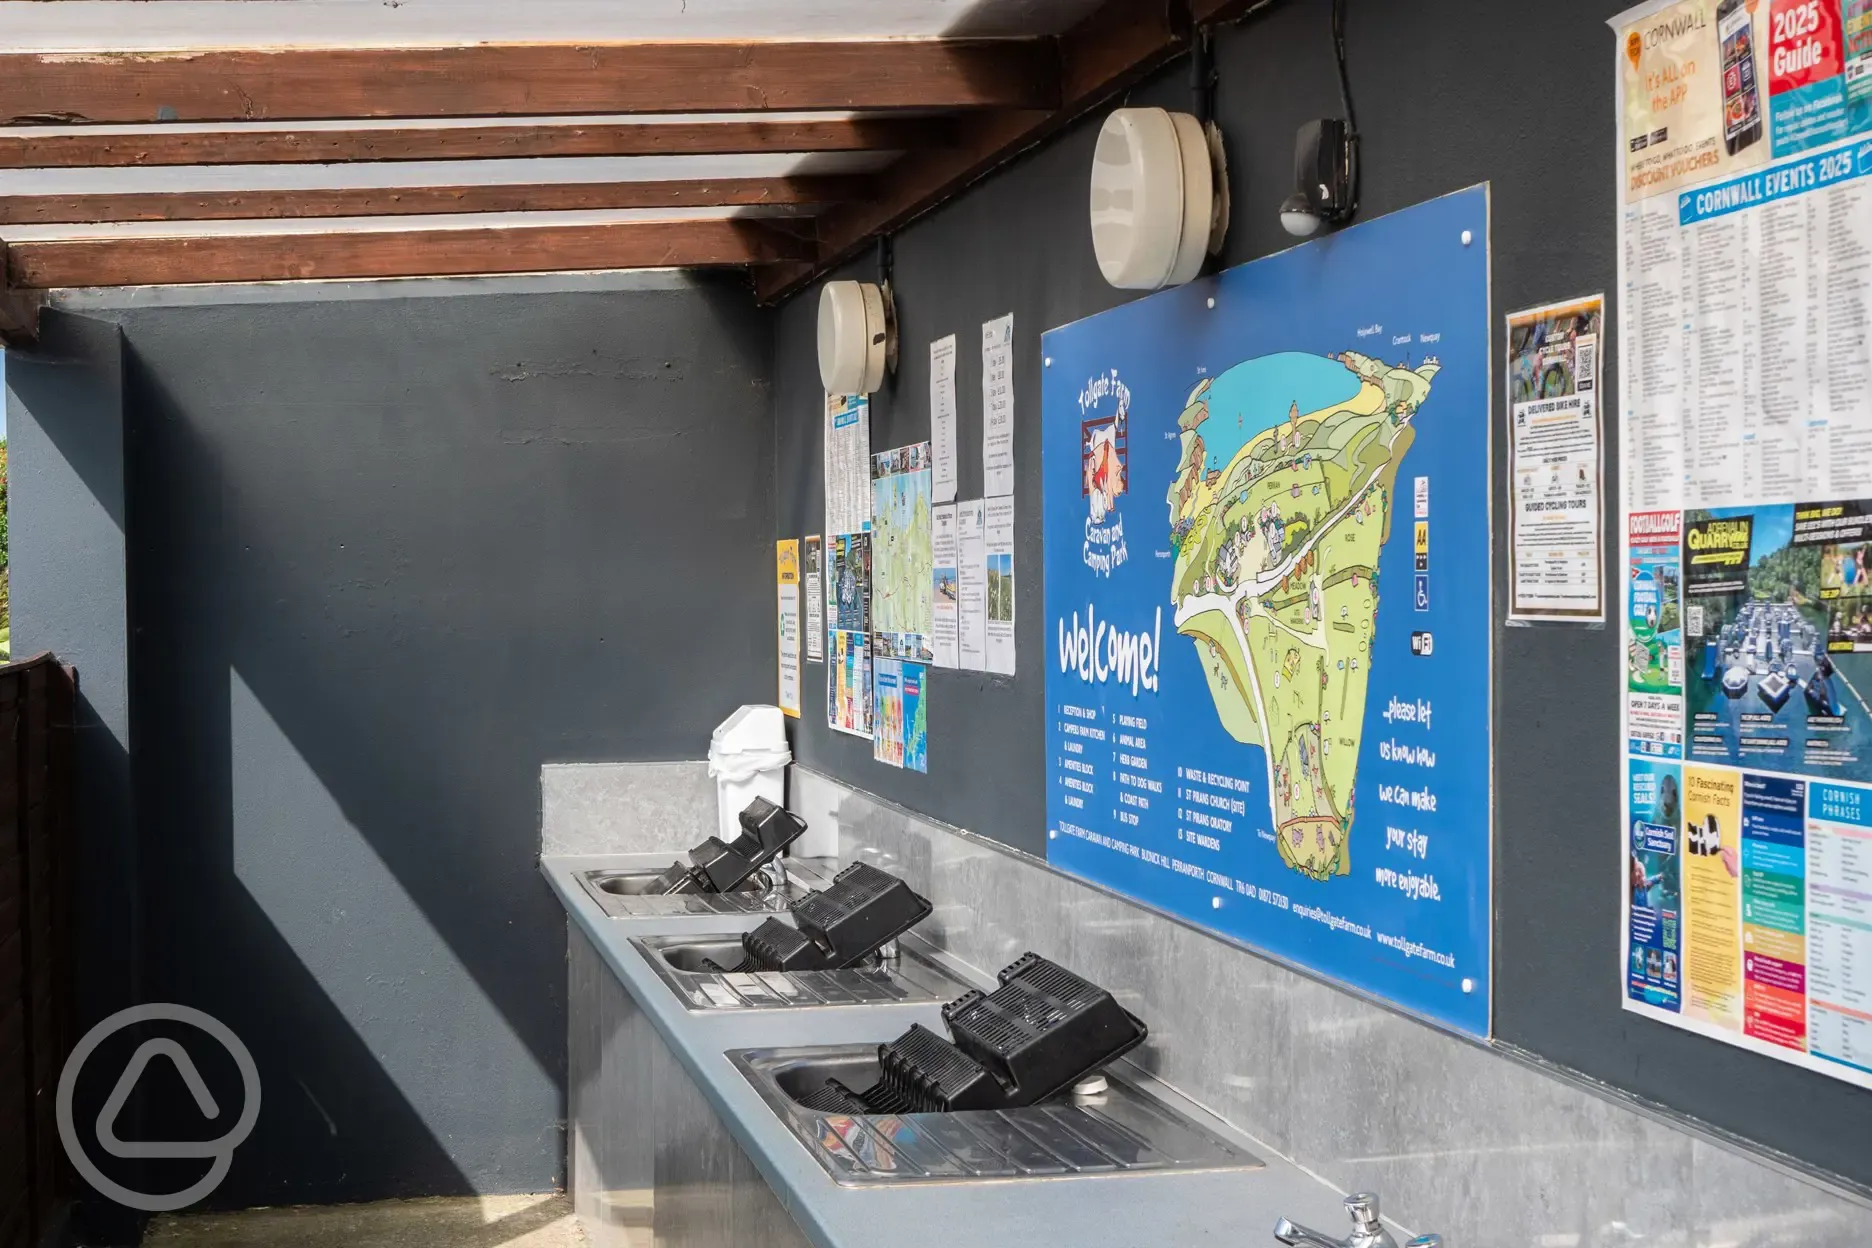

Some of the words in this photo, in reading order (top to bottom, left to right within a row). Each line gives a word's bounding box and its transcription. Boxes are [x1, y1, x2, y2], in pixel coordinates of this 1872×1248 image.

[1643, 11, 1706, 51] CORNWALL
[1773, 0, 1819, 44] 2025
[1773, 36, 1822, 77] Guide
[1661, 64, 1681, 87] ALL
[1681, 60, 1696, 79] on
[1652, 94, 1668, 113] the
[1669, 83, 1688, 107] APP
[1631, 163, 1670, 191] DISCOUNT
[1671, 149, 1720, 178] VOUCHERS
[1696, 177, 1763, 215] CORNWALL
[1765, 162, 1815, 197] EVENTS
[1819, 150, 1853, 182] 2025
[1078, 371, 1109, 415] Tollgate
[1110, 368, 1130, 410] Farm
[1528, 401, 1555, 415] DELIVERED
[1556, 399, 1568, 411] BIKE
[1568, 398, 1581, 410] HIRE
[1525, 502, 1544, 512] GUIDED
[1545, 500, 1567, 511] CYCLING
[1567, 499, 1587, 510] TOURS
[1085, 517, 1111, 546] Caravan
[1111, 512, 1123, 541] and
[1707, 520, 1749, 534] ADRENALIN
[1416, 529, 1427, 547] AA
[1688, 528, 1734, 550] QUARRY
[1083, 541, 1110, 579] Camping
[1110, 540, 1128, 570] Park
[1058, 602, 1162, 697] Welcome!
[1063, 705, 1082, 718] RECEPTION
[1086, 708, 1097, 720] SHOP
[1417, 698, 1433, 730] let
[1631, 700, 1643, 708] OPEN
[1648, 702, 1660, 710] DAYS
[1119, 714, 1136, 727] PLAYING
[1136, 717, 1148, 730] FIELD
[1089, 727, 1106, 741] KITCHEN
[1119, 734, 1134, 747] ANIMAL
[1135, 737, 1146, 750] AREA
[1119, 753, 1130, 765] HERB
[1130, 755, 1148, 769] GARDEN
[1391, 738, 1416, 764] know
[1416, 745, 1436, 768] how
[1081, 763, 1094, 775] BLOCK
[1082, 781, 1094, 794] BLOCK
[1119, 772, 1130, 784] PATH
[1130, 775, 1136, 787] TO
[1137, 777, 1147, 789] DOG
[1147, 779, 1162, 793] WALKS
[1186, 768, 1202, 782] WASTE
[1207, 772, 1234, 790] RECYCLING
[1234, 779, 1250, 793] POINT
[1688, 775, 1695, 787] 10
[1696, 777, 1734, 793] Fascinating
[1124, 793, 1138, 806] COAST
[1138, 797, 1149, 809] PATH
[1186, 788, 1192, 800] ST
[1192, 791, 1209, 806] PIRANS
[1210, 795, 1230, 811] CHURCH
[1230, 798, 1245, 817] (SITE)
[1411, 786, 1437, 812] make
[1688, 791, 1712, 805] Cornish
[1713, 795, 1730, 807] Facts
[1822, 788, 1860, 805] CORNISH
[1120, 811, 1128, 823] BUS
[1128, 813, 1139, 826] STOP
[1186, 809, 1192, 821] ST
[1192, 811, 1209, 827] PIRANS
[1209, 816, 1232, 833] ORATORY
[1822, 803, 1860, 820] PHRASES
[1186, 830, 1196, 843] SITE
[1196, 833, 1220, 851] WARDENS
[1385, 826, 1406, 850] your
[1406, 828, 1428, 860] stay
[1645, 827, 1663, 836] Cornish
[1663, 829, 1674, 838] Seal
[1647, 837, 1672, 852] Sanctuary
[1059, 820, 1076, 836] TOLLGATE
[1076, 826, 1086, 839] FARM
[1085, 829, 1102, 846] CARAVAN
[1102, 835, 1111, 849] AND
[1111, 838, 1129, 855] CAMPING
[1141, 848, 1160, 865] BUDNICK
[1171, 858, 1205, 880] PERRANPORTH
[1206, 870, 1234, 891] CORNWALL
[1235, 879, 1245, 895] TR6
[1258, 887, 1272, 905] 01872
[1292, 902, 1372, 940] enquiries@tollgatefarm.co.uk
[1376, 932, 1456, 968] www.tollgatefarm.co.uk
[1375, 866, 1397, 889] more
[1398, 869, 1442, 902] enjoyable.
